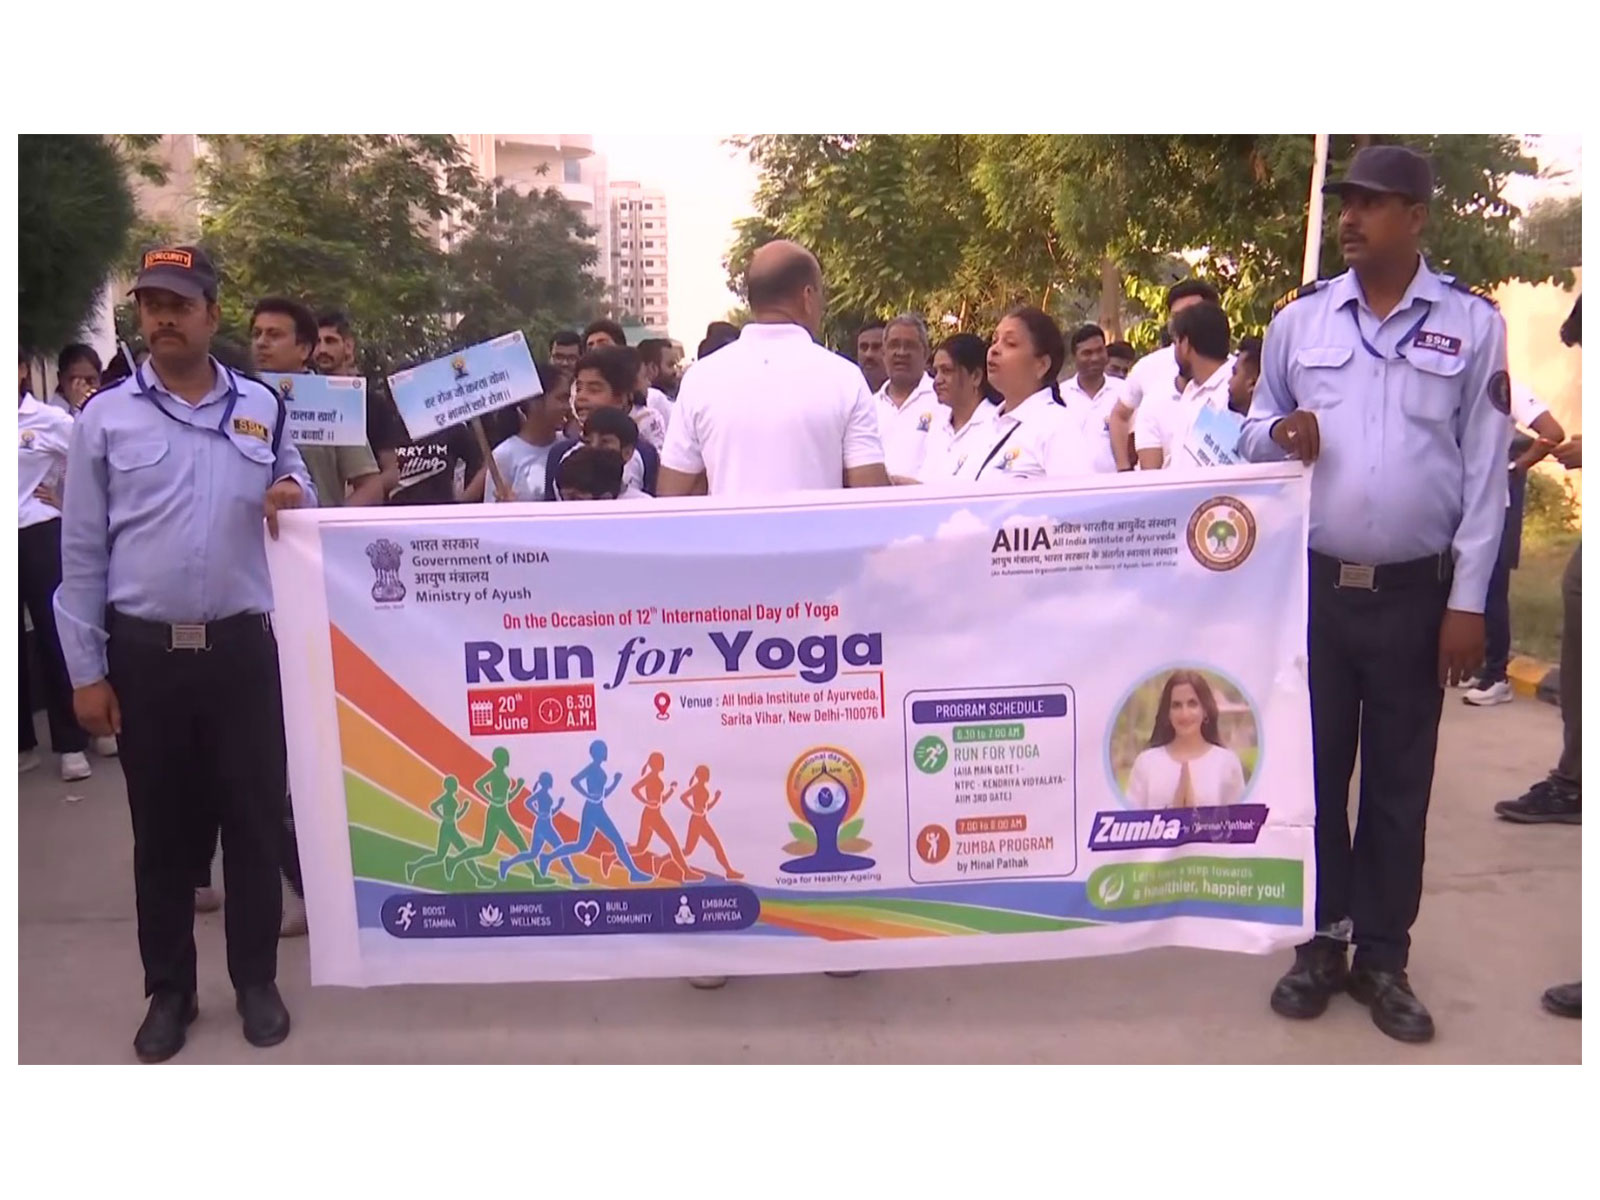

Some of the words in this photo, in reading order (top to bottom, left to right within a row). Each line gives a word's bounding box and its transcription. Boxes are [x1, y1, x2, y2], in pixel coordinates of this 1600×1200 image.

[1425, 334, 1450, 348] SSM
[290, 410, 315, 421] कसम
[240, 419, 264, 438] SSM
[395, 446, 425, 456] RRY
[428, 444, 447, 455] I'M
[400, 457, 447, 477] illing
[1052, 521, 1081, 534] अखिल
[1084, 520, 1114, 532] भारतीय
[1118, 517, 1146, 533] आयुर्वेद
[1148, 518, 1176, 529] संस्थान
[410, 539, 438, 551] भारत
[442, 538, 479, 550] सरकार
[991, 526, 1051, 553] AIIA
[1053, 537, 1064, 547] All
[1066, 535, 1086, 546] India
[1089, 535, 1123, 544] Institute
[1125, 533, 1134, 542] of
[1136, 530, 1176, 543] Ayurveda
[412, 554, 492, 567] Government
[496, 552, 508, 565] of
[513, 552, 549, 564] INDIA
[1044, 554, 1063, 562] भारत
[415, 572, 445, 588] आयुष
[450, 569, 489, 583] मंत्रालय
[416, 589, 471, 604] Ministry
[474, 587, 488, 600] of
[492, 587, 532, 603] Ayush
[503, 613, 521, 630] On
[525, 612, 547, 629] the
[551, 610, 614, 628] Occasion
[619, 609, 633, 626] of
[661, 605, 751, 624] International
[756, 604, 782, 623] Day
[786, 602, 800, 619] of
[804, 601, 839, 621] Yoga
[464, 641, 594, 684] Run
[602, 636, 693, 690] for
[708, 630, 882, 684] Yoga
[566, 694, 592, 710] 6.30
[680, 695, 712, 709] Venue
[722, 693, 735, 706] All
[737, 692, 763, 706] India
[766, 691, 810, 705] Institute
[813, 690, 824, 703] of
[827, 687, 879, 705] Ayurveda,
[721, 712, 752, 726] Sarita
[755, 710, 785, 725] Vihar,
[788, 710, 812, 723] New
[814, 706, 878, 722] Delhi-110076
[936, 703, 986, 718] PROGRAM
[989, 700, 1044, 716] SCHEDULE
[494, 714, 529, 730] June
[566, 710, 594, 727] A.M.
[1008, 726, 1020, 737] AM
[954, 747, 978, 761] RUN
[983, 746, 1005, 760] FOR
[1009, 744, 1040, 759] YOGA
[974, 765, 992, 776] MAIN
[995, 764, 1013, 774] GATE
[955, 780, 975, 791] NTPC
[983, 777, 1020, 789] KENDRIYA
[973, 793, 987, 803] 3RD
[1010, 818, 1022, 829] AM
[1093, 815, 1181, 843] Zumba
[957, 840, 995, 855] ZUMBA
[999, 836, 1053, 852] PROGRAM
[957, 860, 967, 874] by
[971, 858, 994, 871] Minal
[997, 857, 1029, 869] Pathak
[1188, 866, 1209, 876] step
[1212, 866, 1254, 878] towards
[776, 876, 798, 886] Yoga
[800, 875, 812, 883] for
[814, 873, 848, 883] Healthy
[850, 872, 882, 882] Ageing
[1203, 878, 1253, 898] happier
[1257, 882, 1285, 900] you!
[422, 906, 446, 916] BOOST
[509, 904, 543, 915] IMPROVE
[606, 901, 628, 911] BUILD
[702, 898, 738, 909] EMBRACE
[423, 918, 456, 928] STAMINA
[510, 916, 551, 927] WELLNESS
[606, 913, 652, 924] COMMUNITY
[702, 911, 742, 922] AYURVEDA
